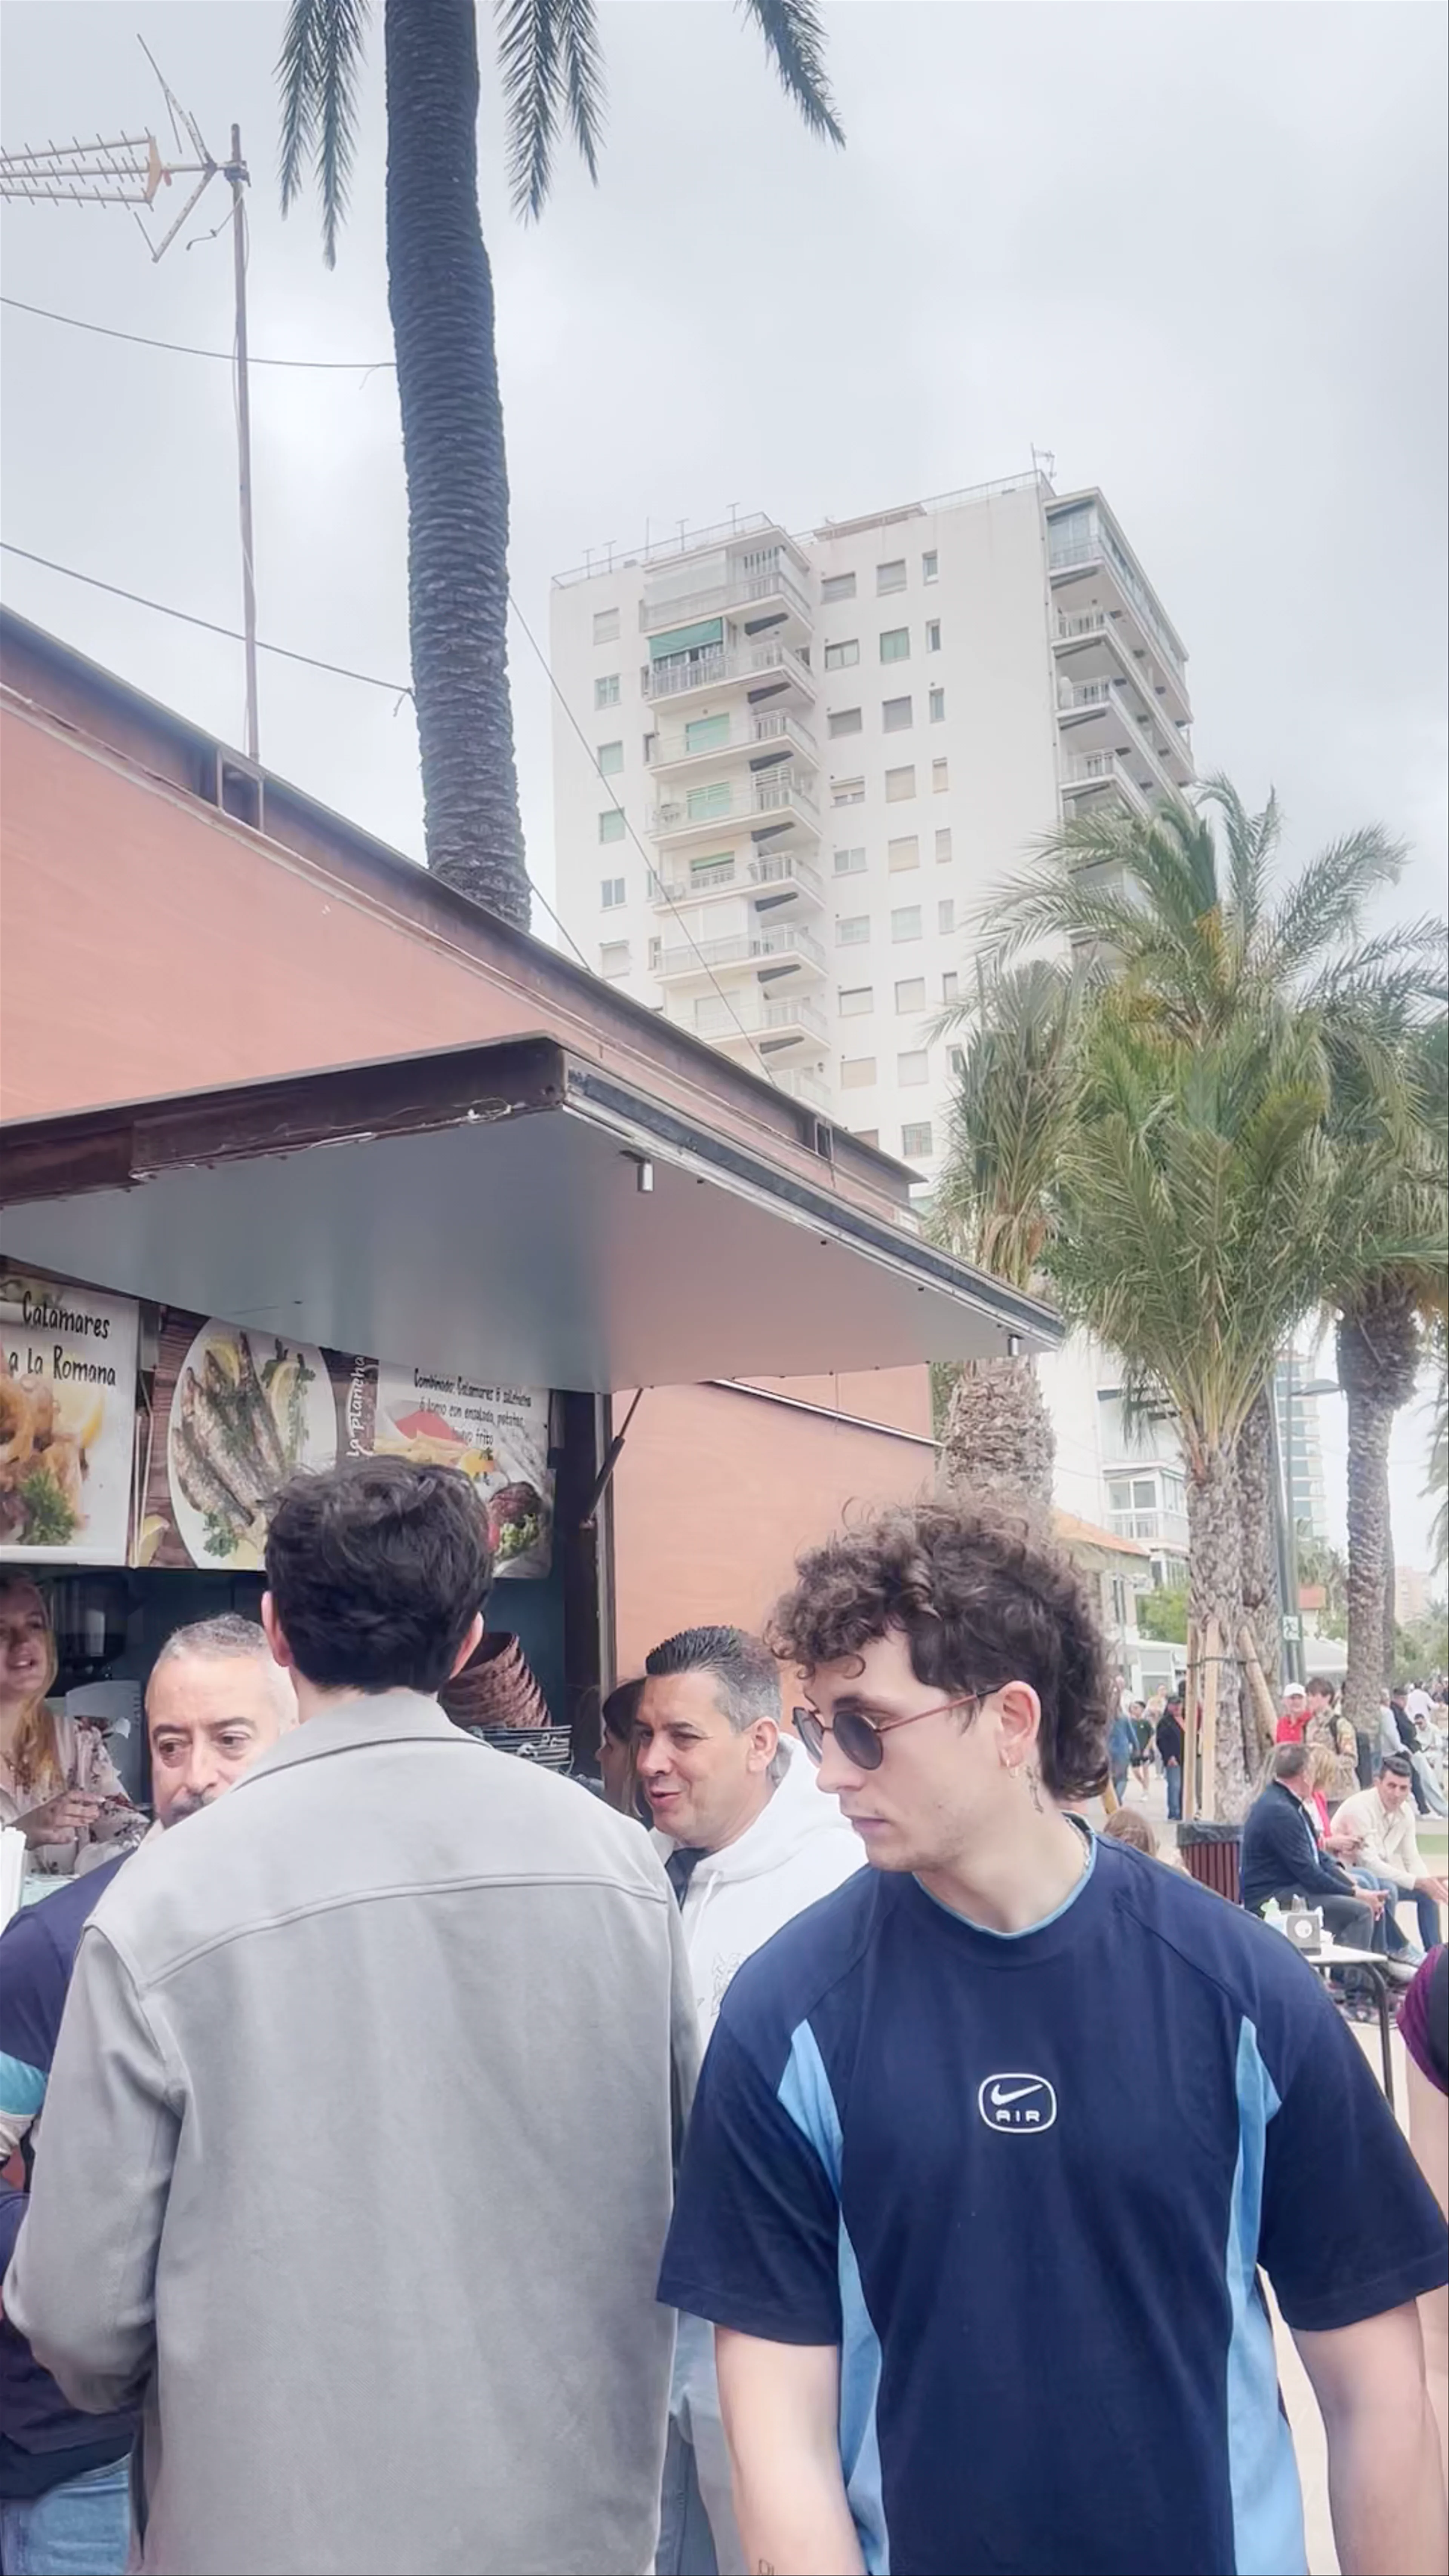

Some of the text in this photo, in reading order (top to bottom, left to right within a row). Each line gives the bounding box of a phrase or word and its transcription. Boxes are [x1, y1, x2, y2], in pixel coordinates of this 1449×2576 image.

[23, 1291, 110, 1339] Calamares
[9, 1345, 116, 1386] a la Romana
[475, 1428, 494, 1446] frito
[996, 2110, 1040, 2122] AIR
